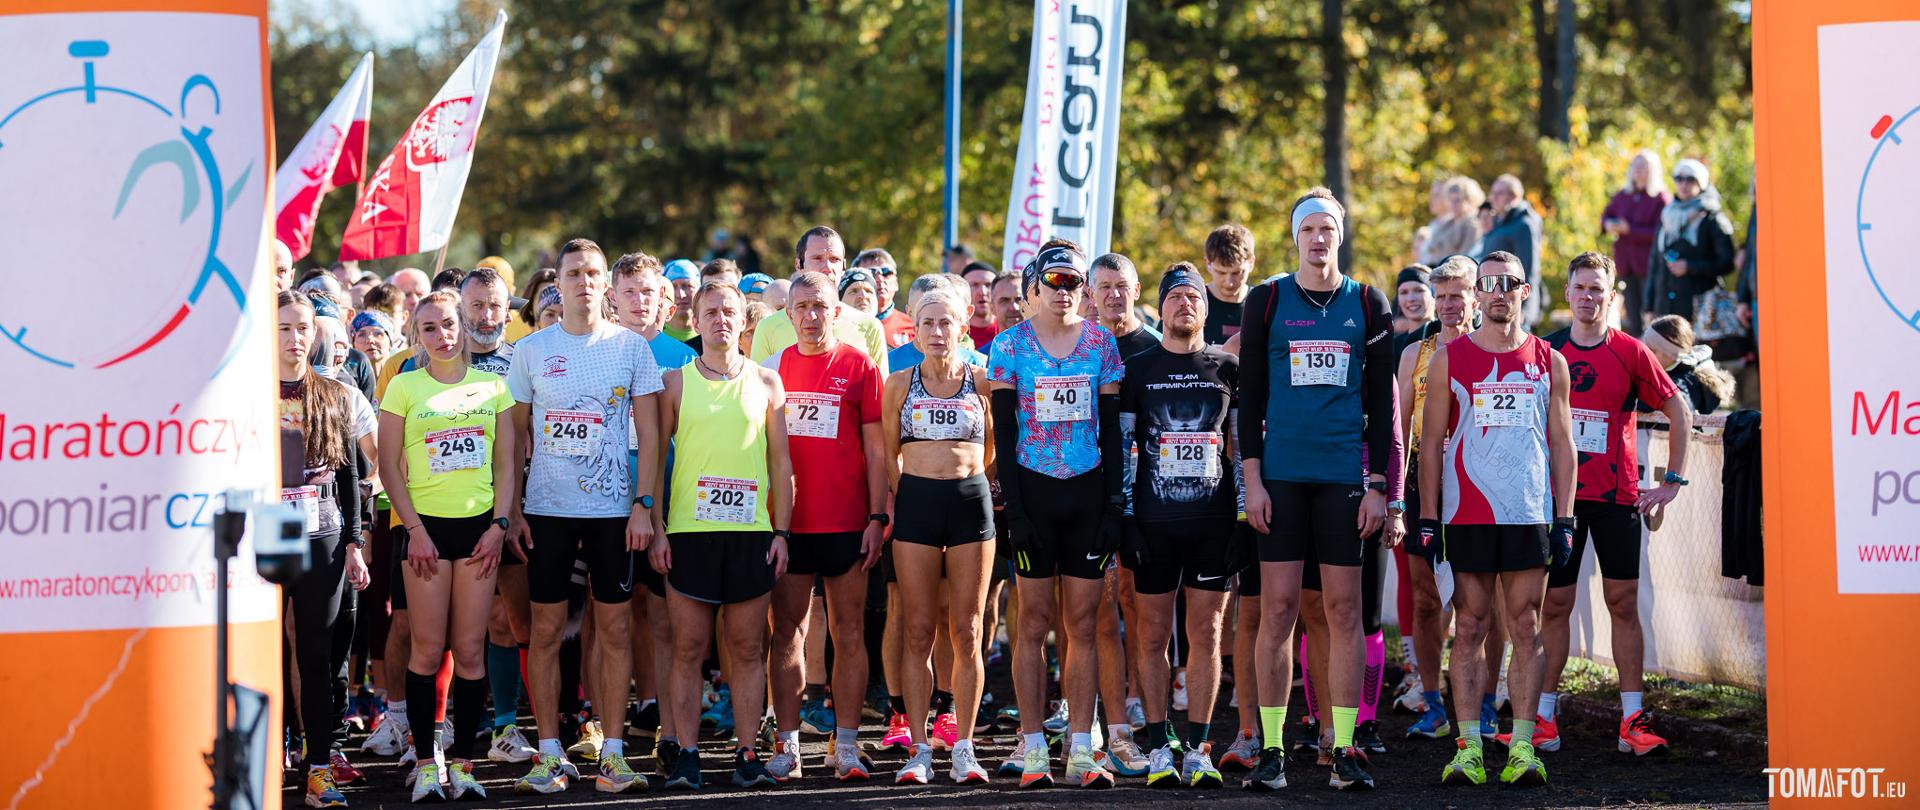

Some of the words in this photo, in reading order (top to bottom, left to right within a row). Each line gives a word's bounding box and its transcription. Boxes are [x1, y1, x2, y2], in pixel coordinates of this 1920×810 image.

[1305, 353, 1336, 369] 130
[1053, 389, 1077, 405] 40
[1493, 394, 1516, 410] 22
[798, 405, 819, 421] 72
[928, 409, 957, 425] 198
[553, 422, 588, 439] 248
[439, 437, 476, 457] 249
[1174, 445, 1204, 461] 128
[710, 489, 745, 507] 202
